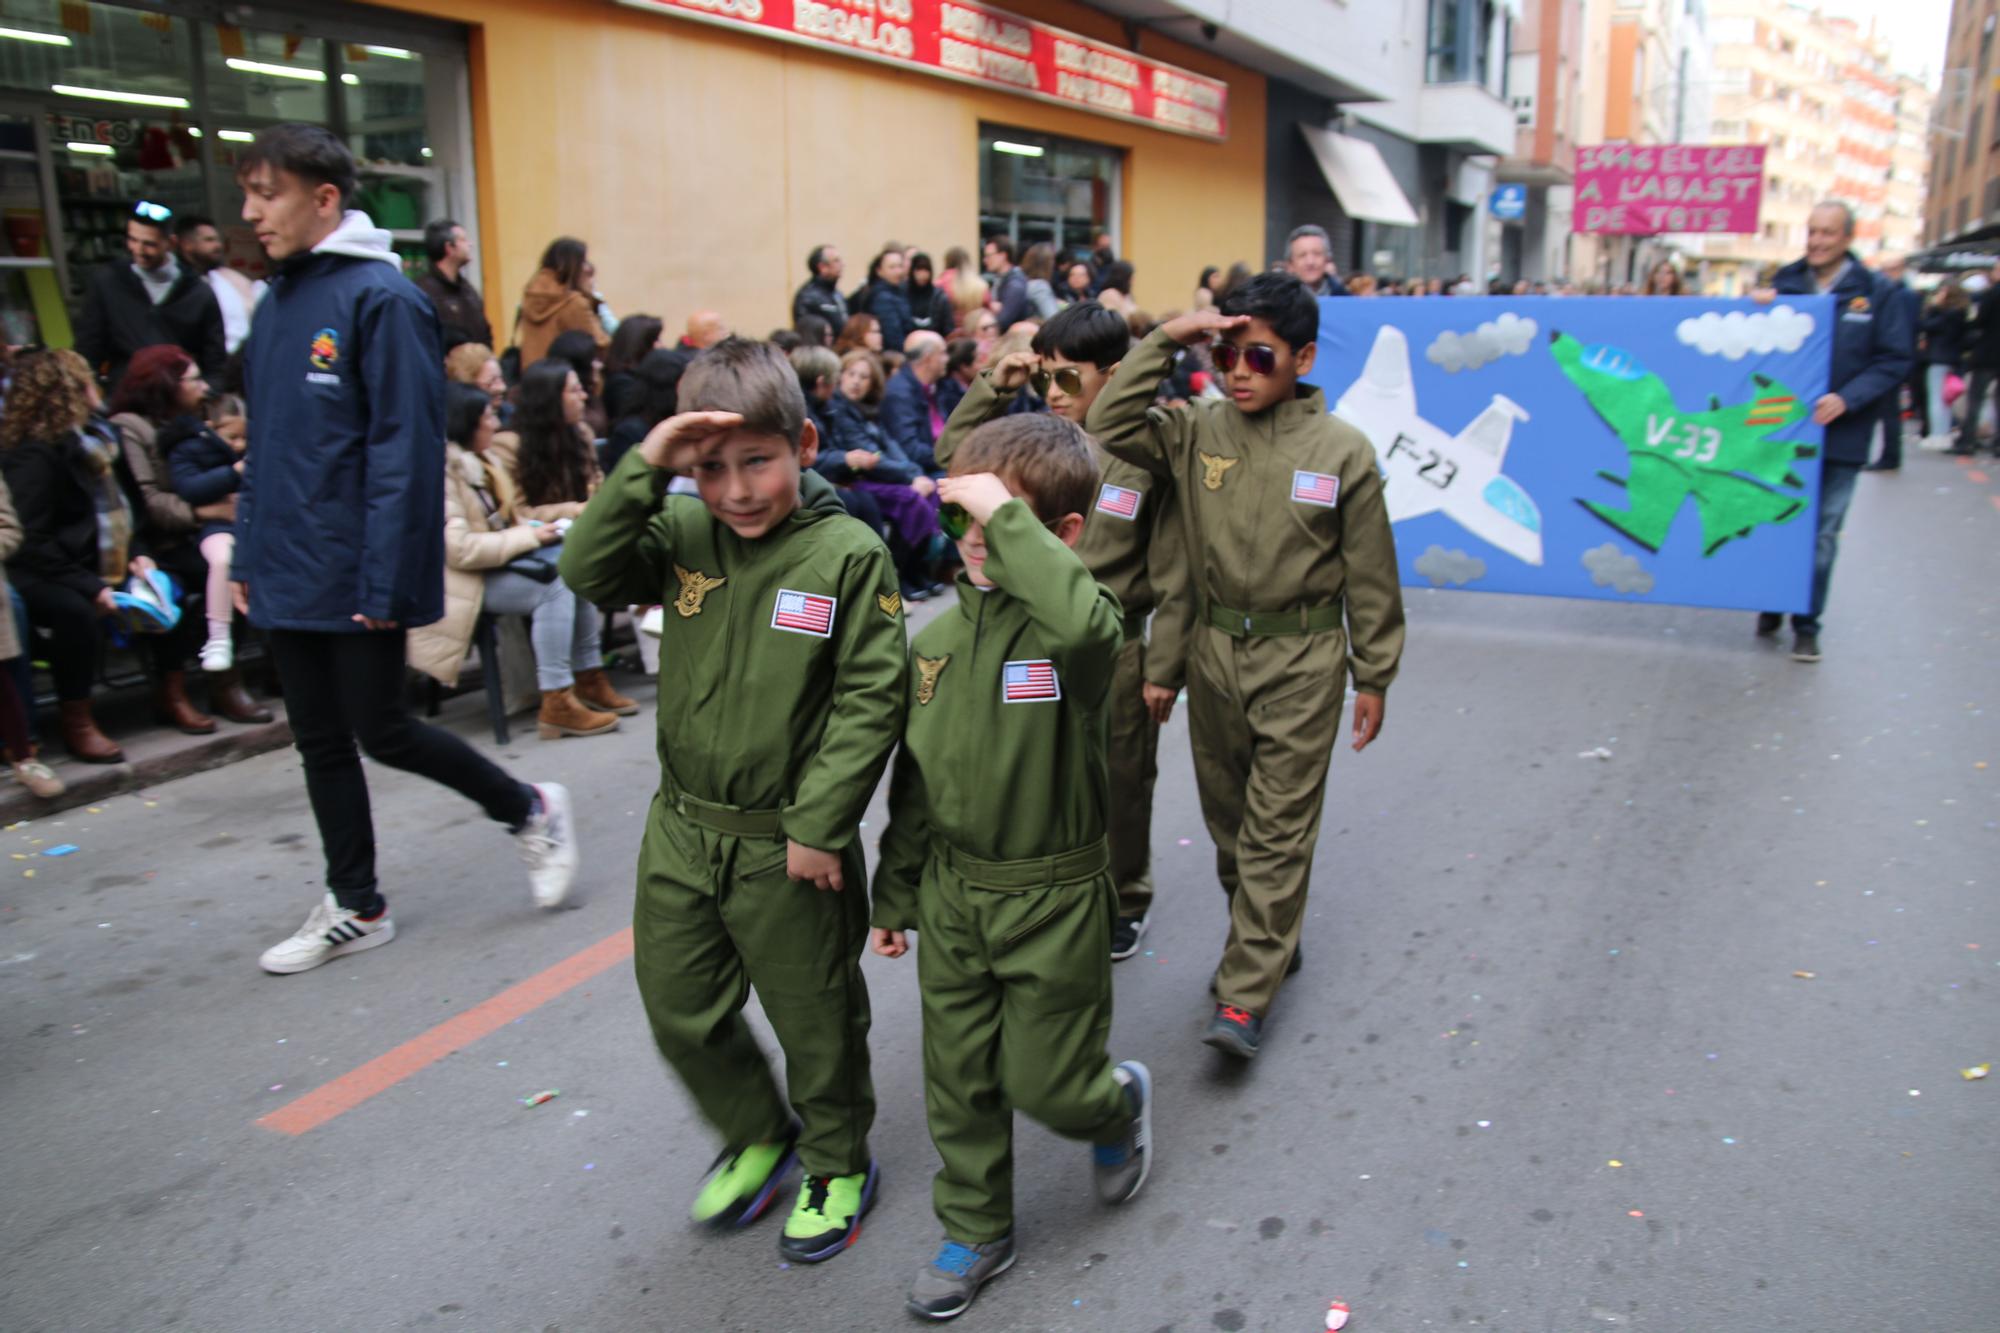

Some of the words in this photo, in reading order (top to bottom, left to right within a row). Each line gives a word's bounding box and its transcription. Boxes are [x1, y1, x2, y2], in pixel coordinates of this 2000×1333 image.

[794, 1, 913, 57] REGALOS
[1659, 147, 1700, 173] EL
[1704, 147, 1761, 174] CEL
[1579, 178, 1602, 202] A
[1618, 175, 1758, 202] L'ABAST
[1585, 205, 1627, 231] DE
[1647, 206, 1732, 231] TOTS
[1646, 413, 1722, 463] V-33
[1386, 432, 1459, 489] F-23
